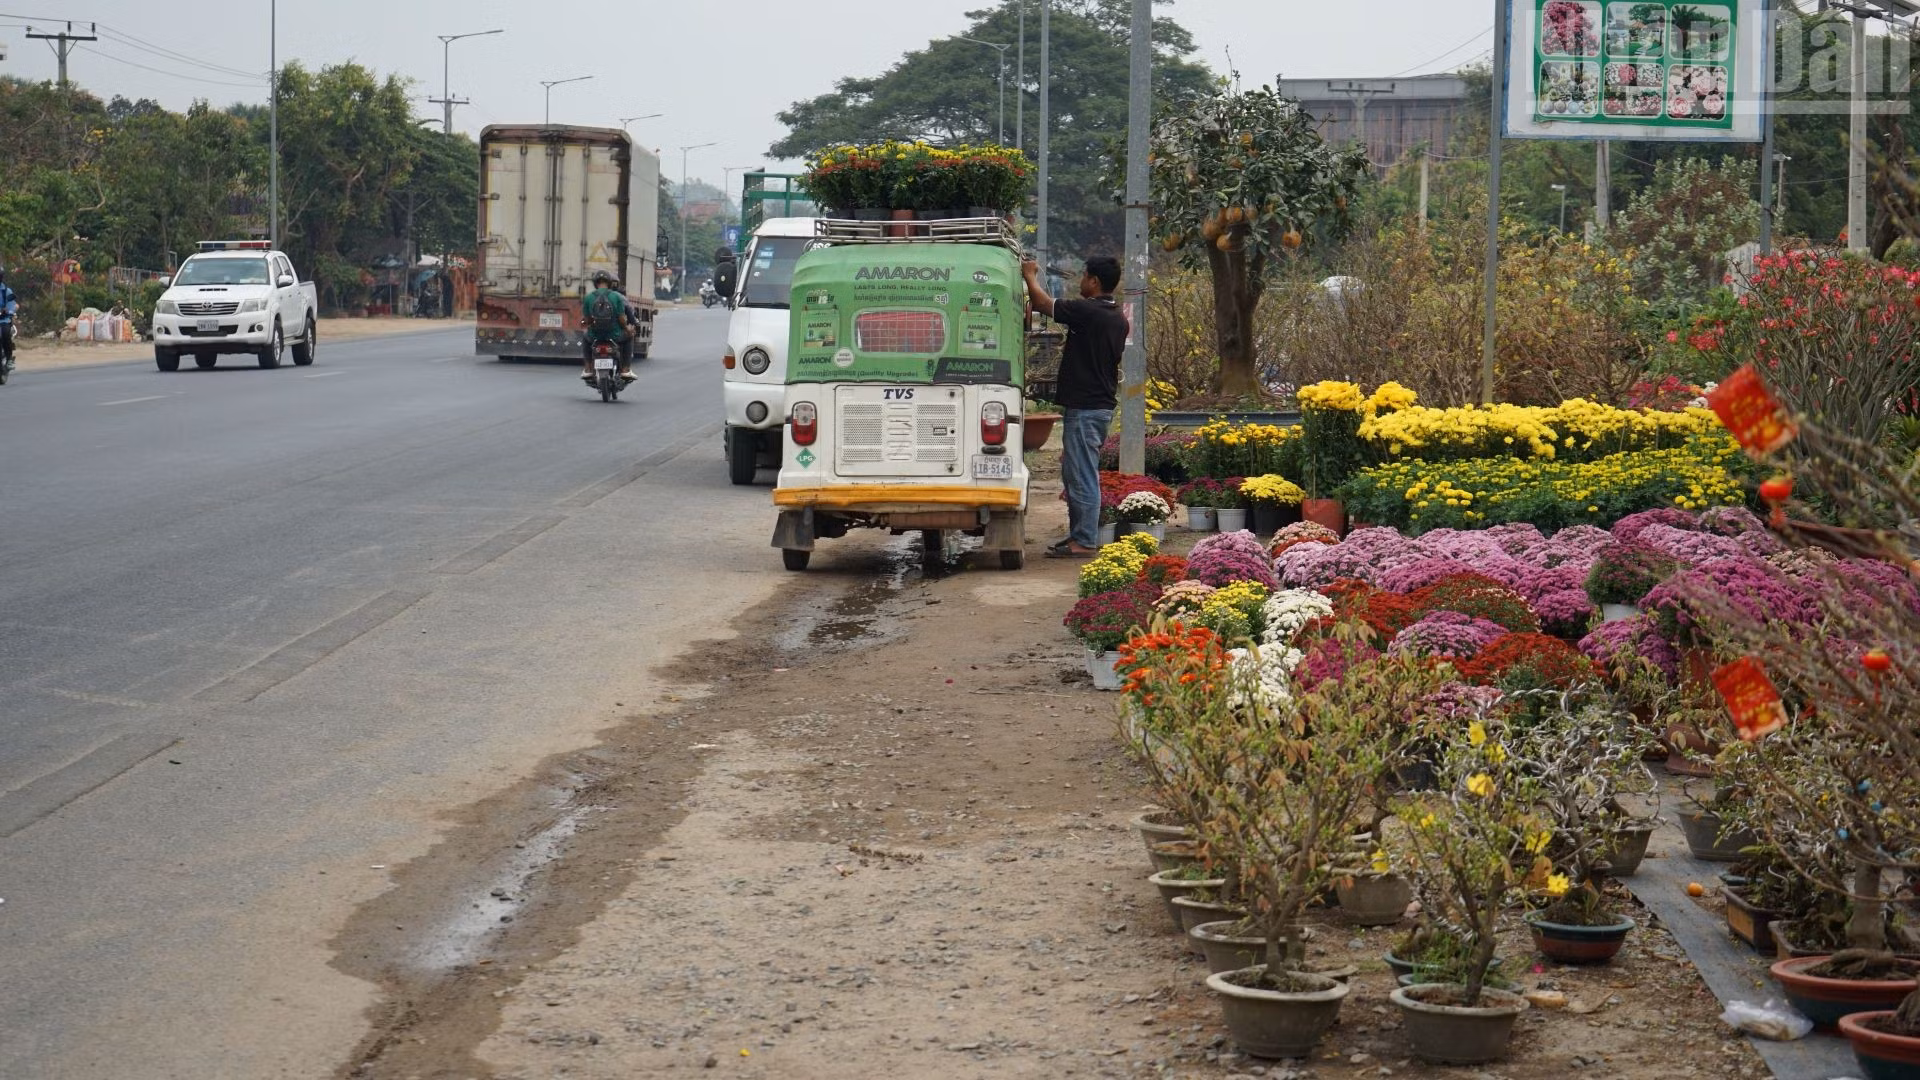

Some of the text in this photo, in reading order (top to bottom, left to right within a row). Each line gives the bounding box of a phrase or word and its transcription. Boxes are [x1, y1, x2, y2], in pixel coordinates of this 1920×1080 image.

[855, 266, 950, 281] AMARON
[799, 356, 832, 365] AMARON
[946, 361, 994, 372] AMARON
[884, 388, 914, 400] TVS
